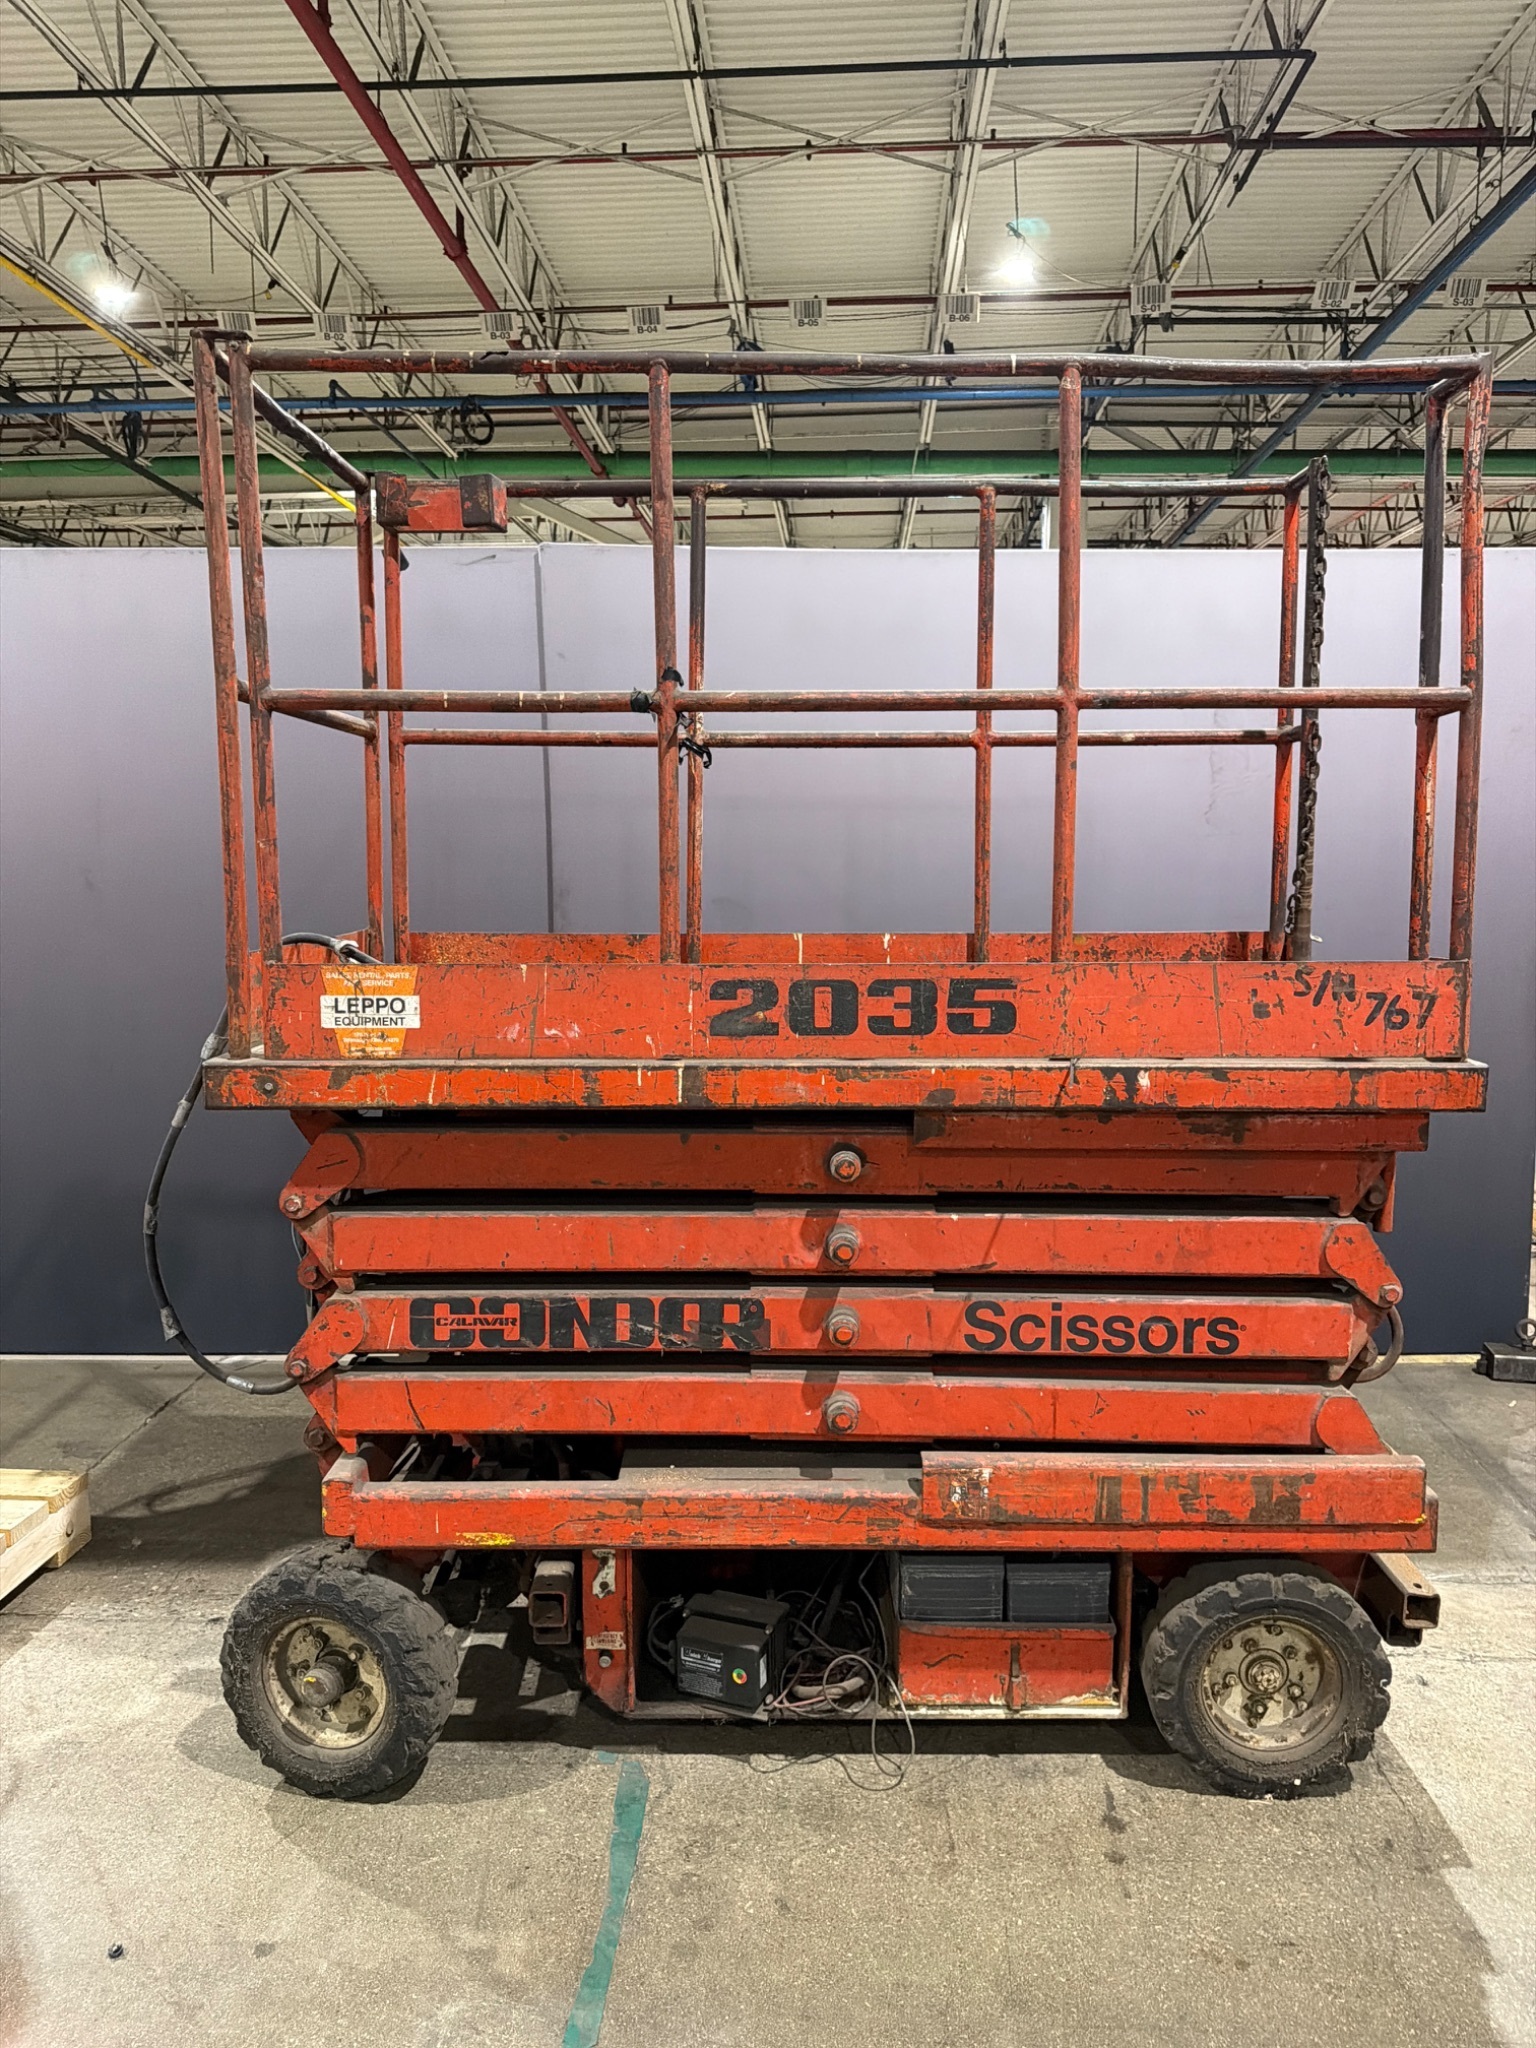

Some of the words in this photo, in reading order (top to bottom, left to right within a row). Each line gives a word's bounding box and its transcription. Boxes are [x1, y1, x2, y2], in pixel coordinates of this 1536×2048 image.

[1320, 299, 1343, 309] S-02
[1452, 297, 1475, 307] S-03
[1140, 304, 1161, 314] S-01
[797, 317, 819, 328] B-05
[948, 312, 970, 323] B-06
[637, 325, 658, 335] B-04
[323, 332, 345, 342] B-02
[490, 331, 511, 341] B-03
[362, 979, 394, 987] SERVICE
[334, 997, 405, 1014] LEPPO
[708, 978, 1017, 1036] 2035
[1364, 987, 1439, 1031] 767
[334, 1016, 406, 1027] EQUIPMENT
[409, 1296, 769, 1349] CONDOR
[435, 1316, 518, 1327] CALAVAR
[963, 1300, 1241, 1356] Scissors
